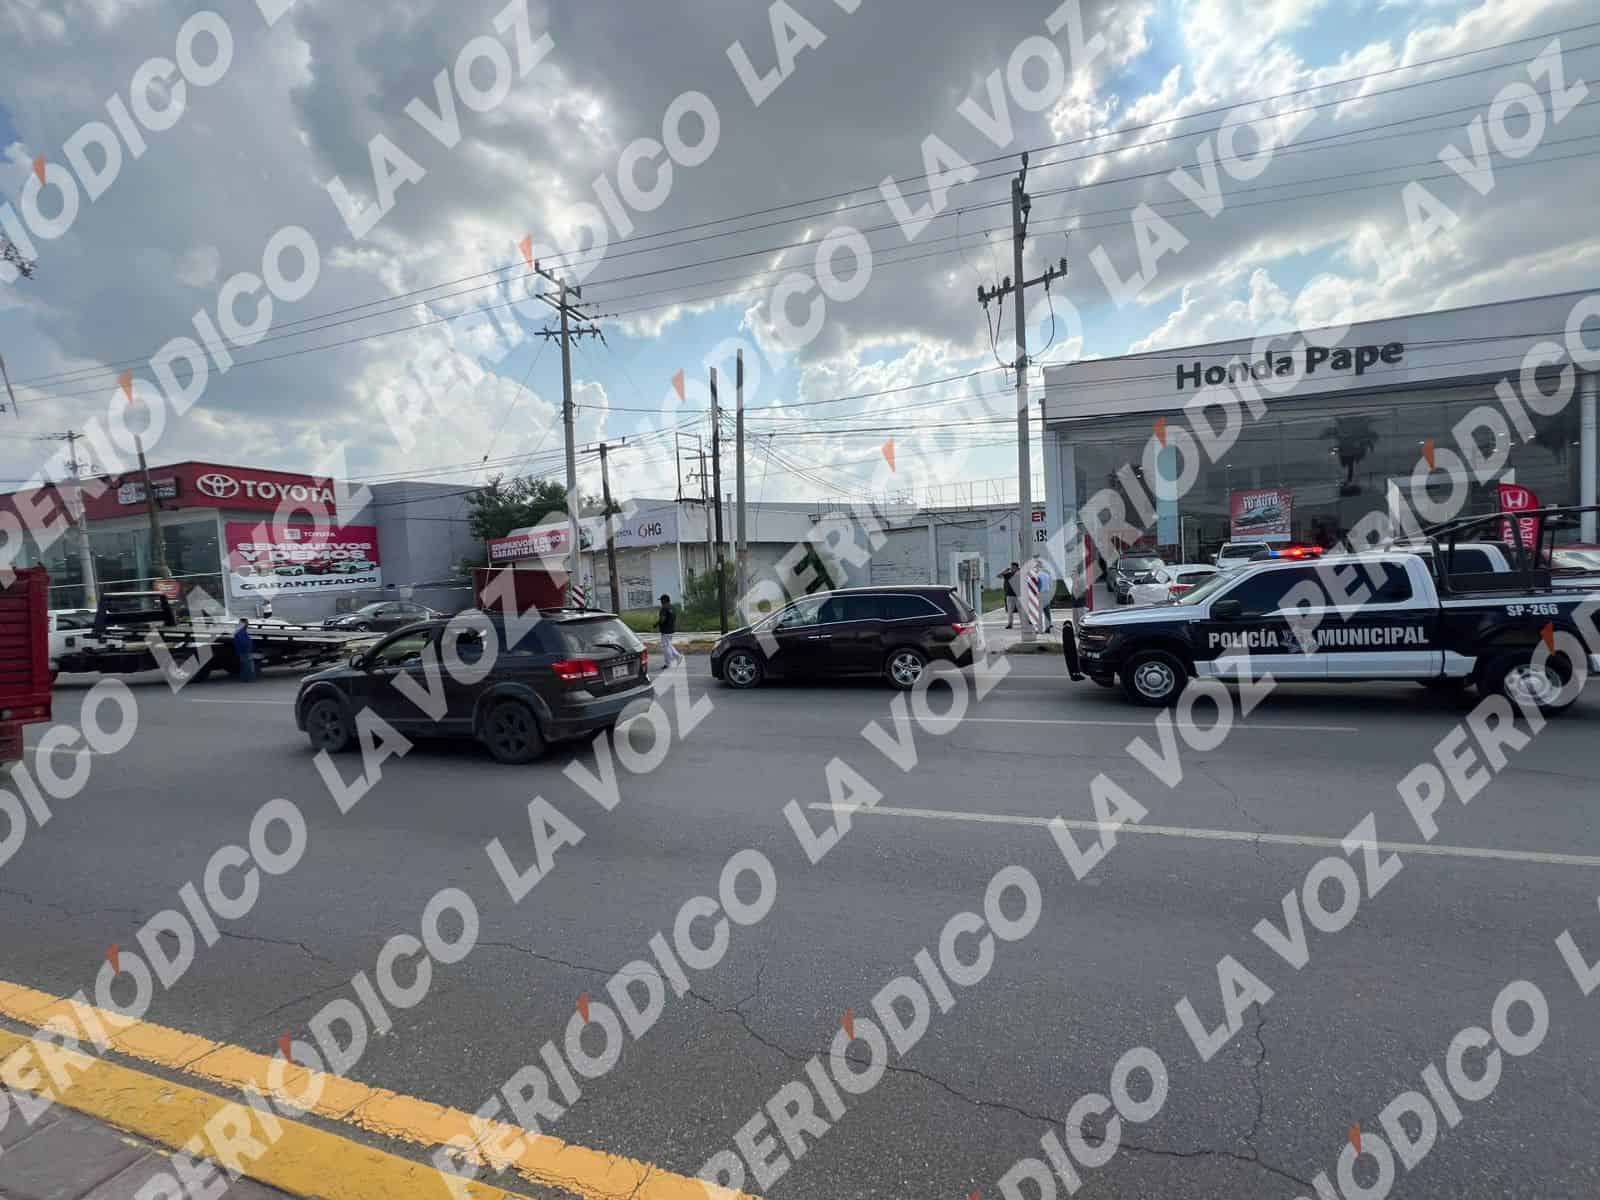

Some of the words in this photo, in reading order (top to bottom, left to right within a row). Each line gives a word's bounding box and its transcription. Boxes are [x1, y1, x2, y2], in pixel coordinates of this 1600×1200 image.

[1177, 350, 1294, 390] Honda
[1306, 342, 1404, 375] Pape
[240, 480, 336, 503] TOYOTA
[237, 542, 372, 551] SEMINUEVOS
[272, 550, 366, 560] DEMOS
[239, 576, 377, 590] GARANTIZADOS
[1506, 603, 1559, 616] SP-266
[1208, 627, 1278, 649] POLICÍA
[1317, 626, 1429, 648] MUNICIPAL
